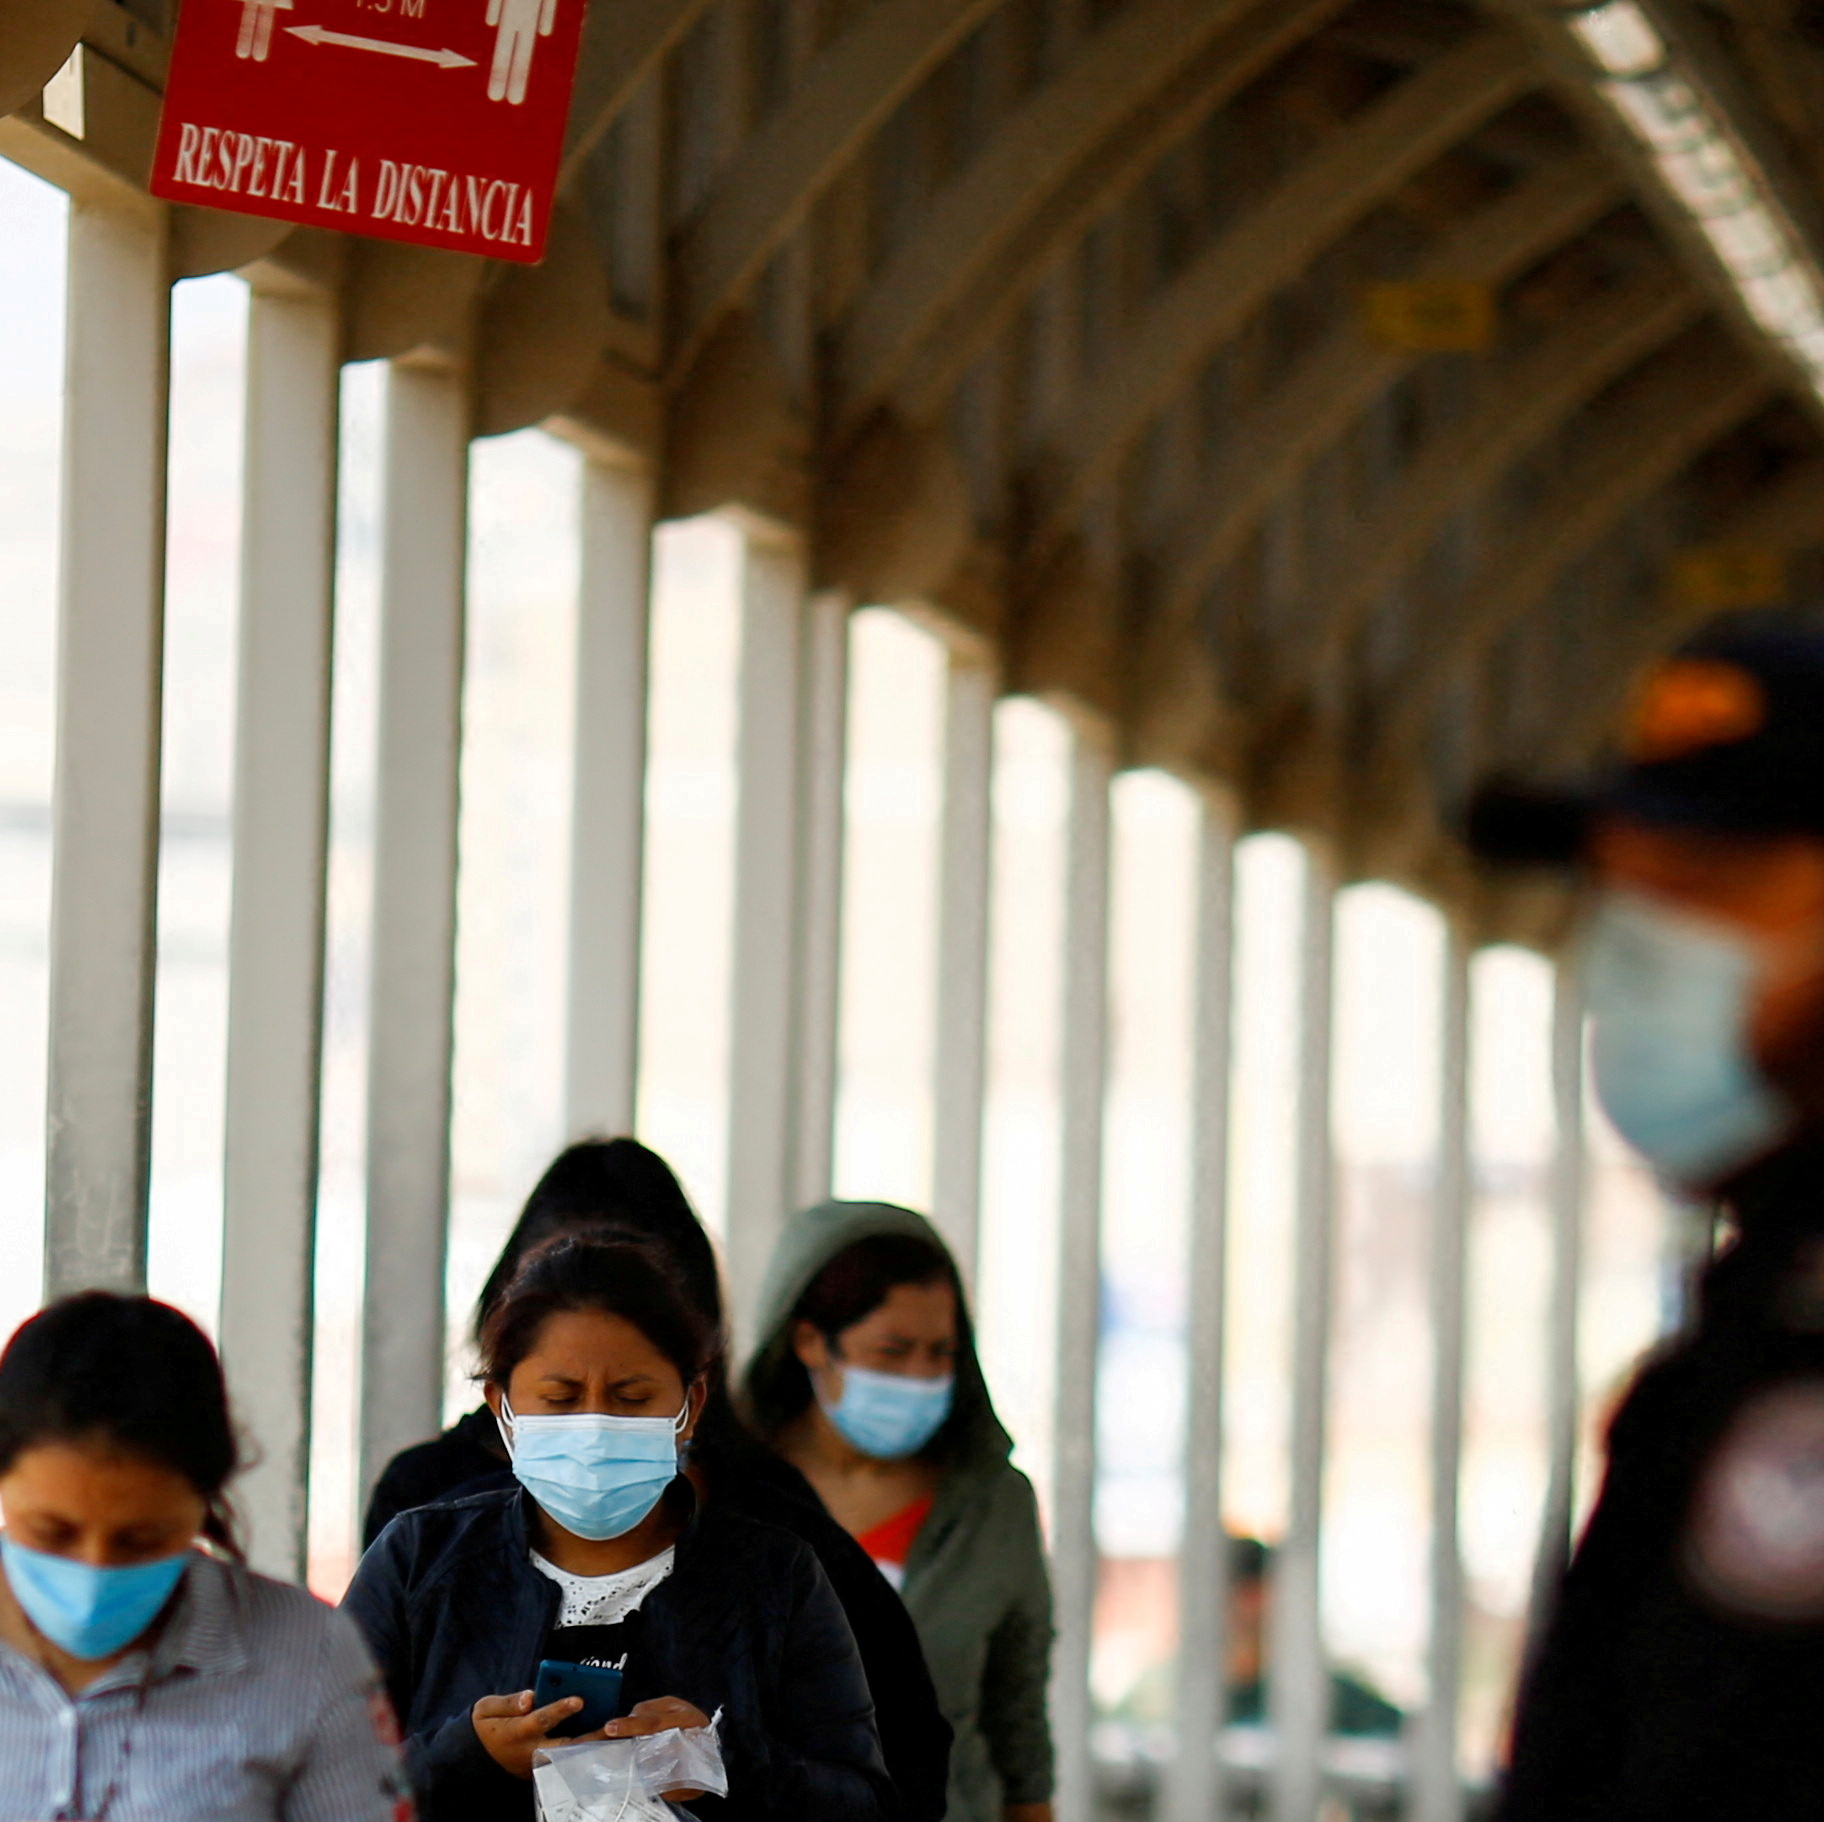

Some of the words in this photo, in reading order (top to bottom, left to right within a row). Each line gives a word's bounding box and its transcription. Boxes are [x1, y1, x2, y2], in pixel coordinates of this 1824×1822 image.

[172, 122, 307, 204] RESPETA
[316, 149, 359, 214] LA
[371, 159, 533, 246] DISTANCIA
